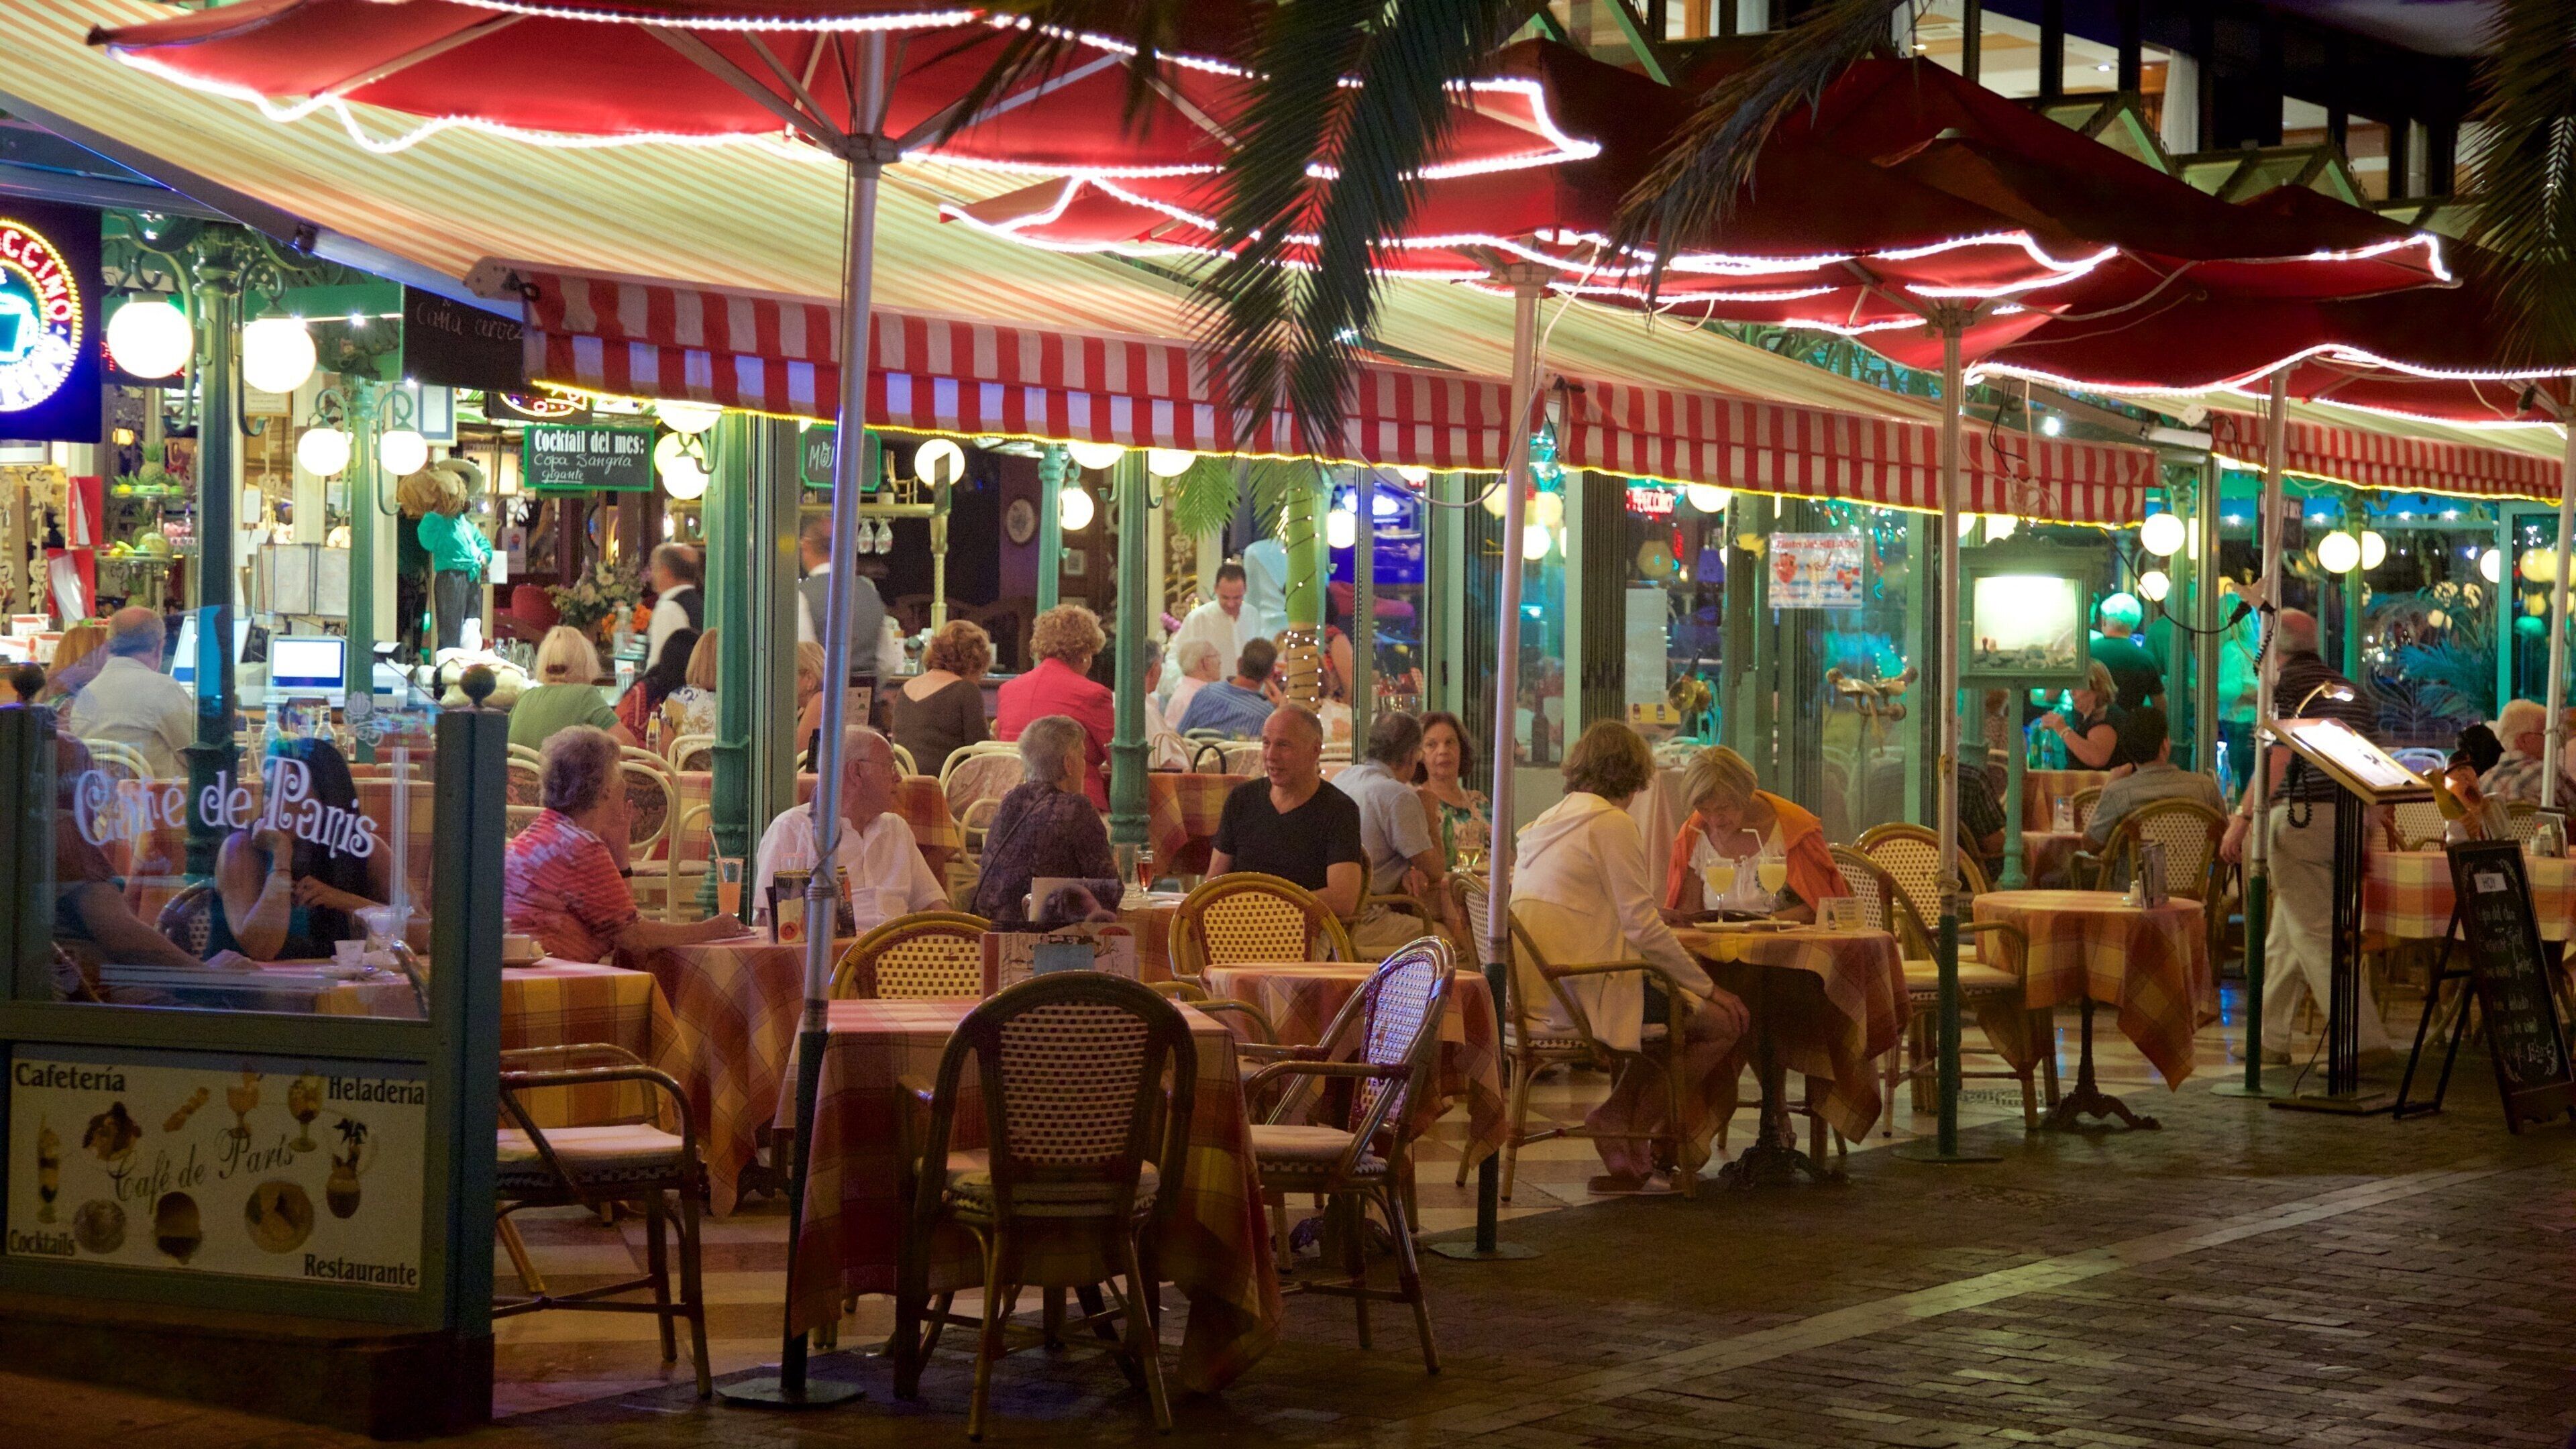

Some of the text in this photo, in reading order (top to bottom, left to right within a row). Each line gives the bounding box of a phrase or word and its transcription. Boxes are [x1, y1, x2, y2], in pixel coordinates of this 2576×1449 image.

[0, 229, 73, 322] CCINO
[534, 429, 645, 455] Cocktail del mes:
[533, 453, 569, 471] Copa
[541, 468, 584, 484] gigante
[74, 756, 378, 859] Café de Paris
[15, 1063, 126, 1092] Cafetería
[329, 1076, 425, 1105] Heladería
[106, 1148, 171, 1215] Café
[178, 1143, 205, 1189] de
[8, 1229, 76, 1257] Cocktails
[304, 1252, 417, 1287] Restaurante
